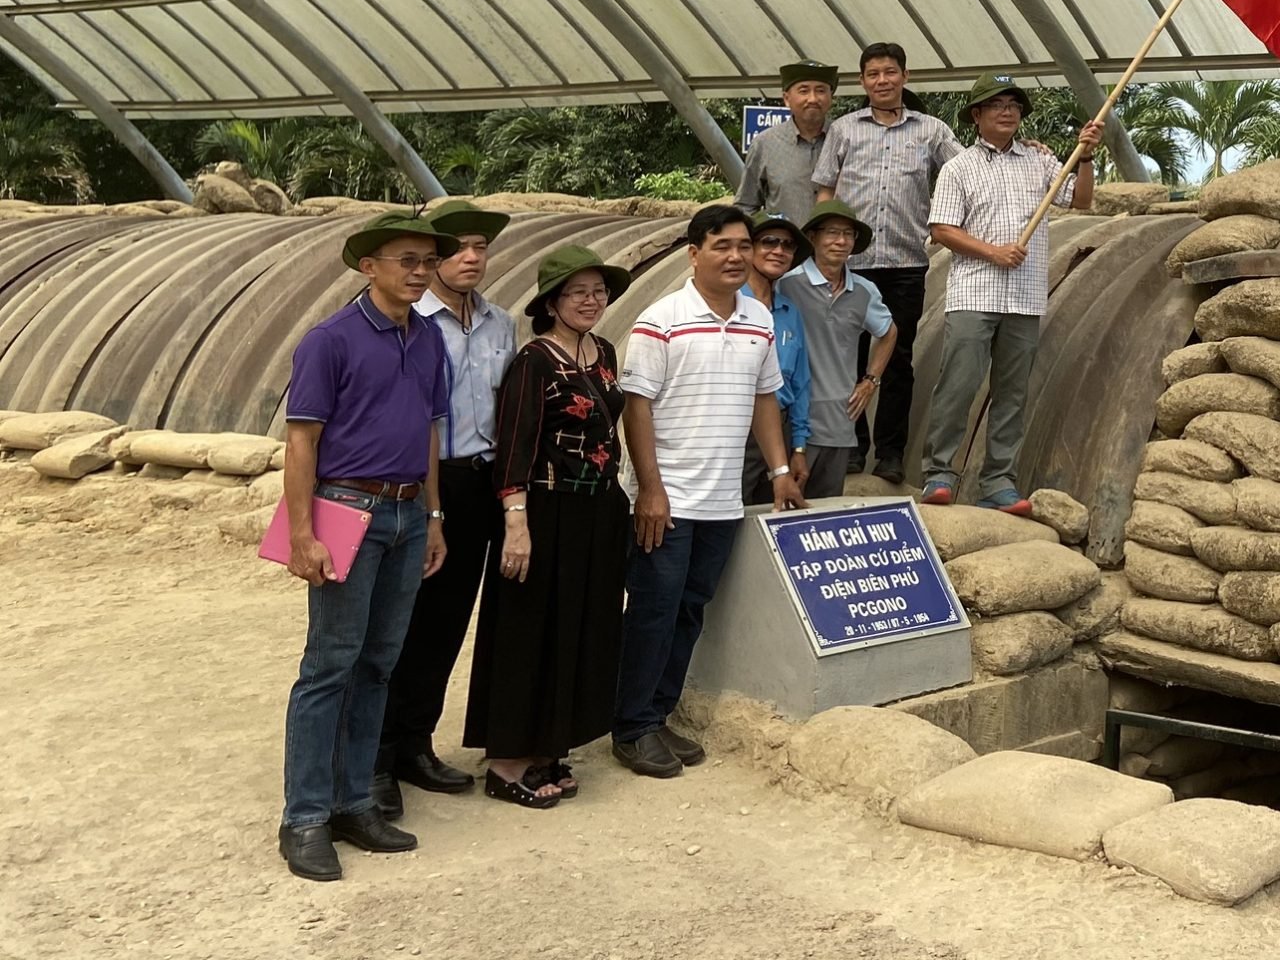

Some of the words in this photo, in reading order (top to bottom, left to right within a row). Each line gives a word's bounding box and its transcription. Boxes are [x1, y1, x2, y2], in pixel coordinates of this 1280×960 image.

[799, 525, 840, 552] HẦM
[839, 519, 868, 547] CHỈ
[866, 522, 897, 543] HUY
[790, 560, 822, 582] TẬP
[824, 553, 868, 574] ĐOÀN
[868, 548, 890, 567] CỨ
[890, 541, 926, 564] ĐIỂM
[820, 578, 857, 600] ĐIỆN
[857, 573, 890, 593] BIÊN
[890, 566, 920, 589] PHỦ
[848, 596, 907, 618] PCGONO
